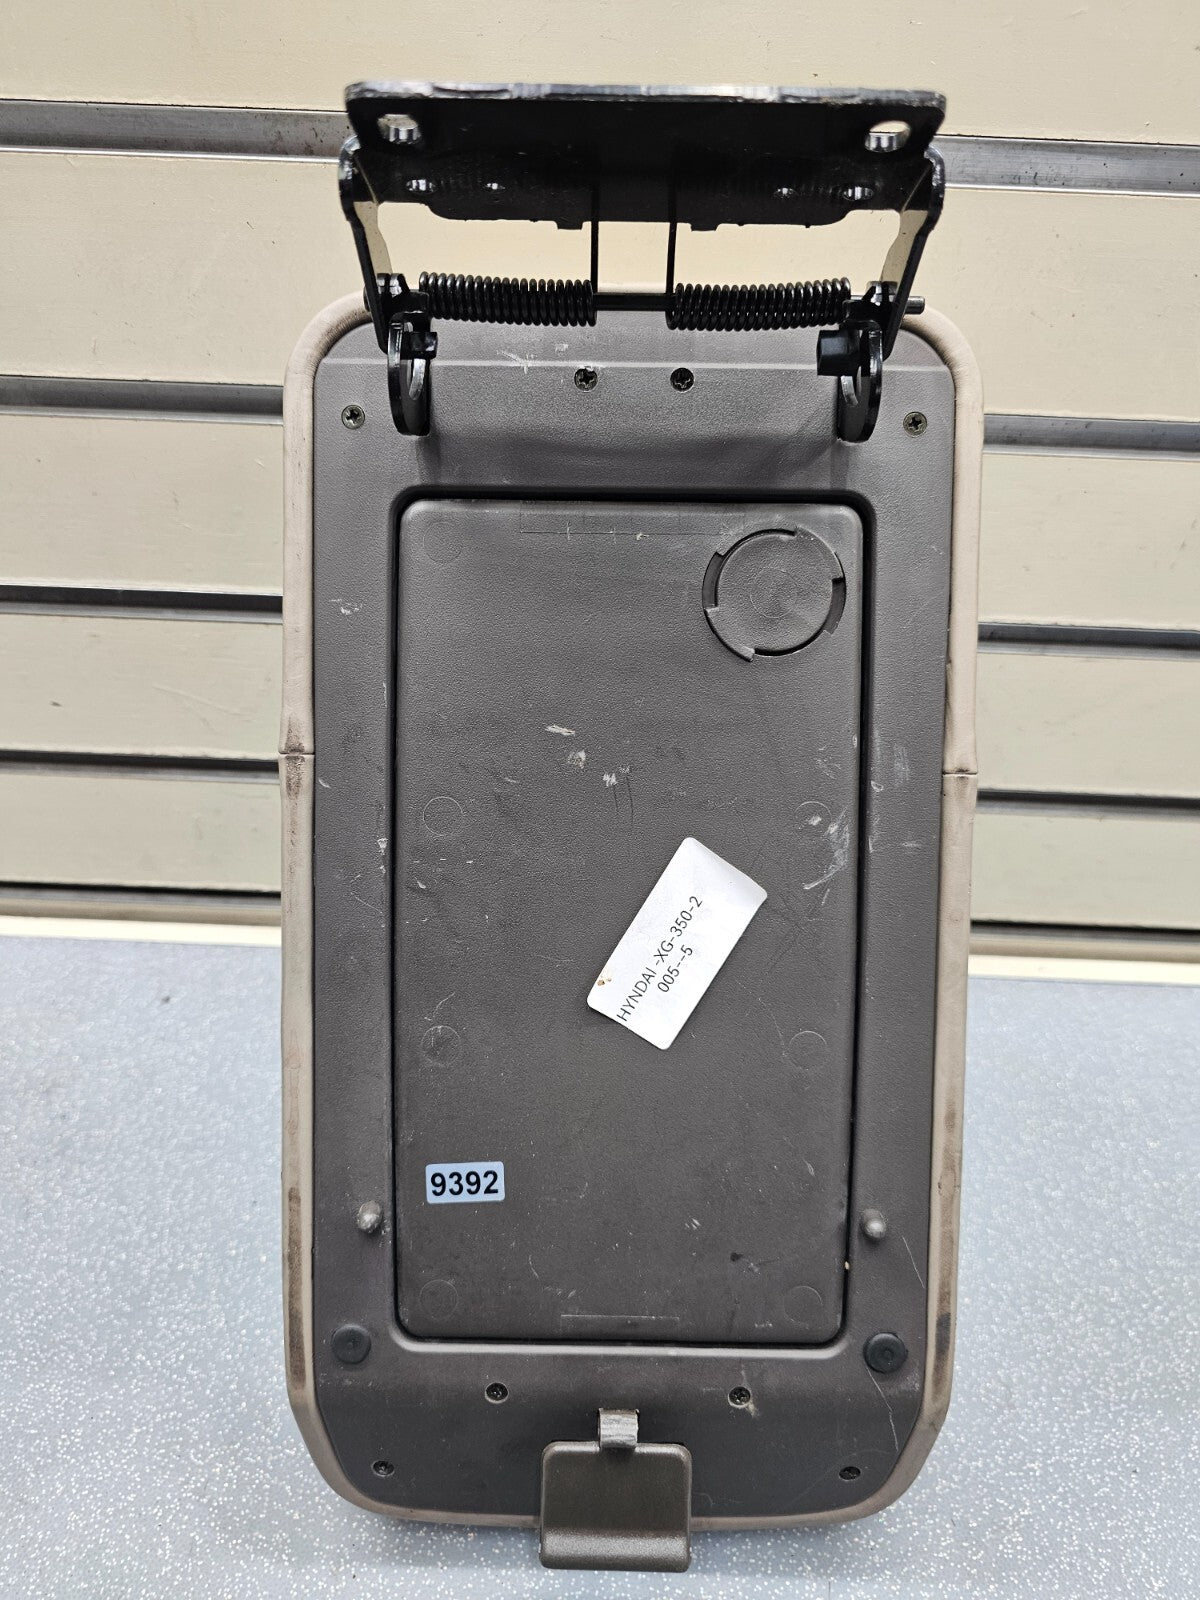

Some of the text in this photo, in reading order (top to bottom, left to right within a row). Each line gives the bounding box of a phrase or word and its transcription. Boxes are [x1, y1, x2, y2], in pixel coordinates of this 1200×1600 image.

[657, 944, 693, 993] 005--5
[616, 967, 657, 1022] HYNDAI
[430, 1170, 499, 1197] 9392
